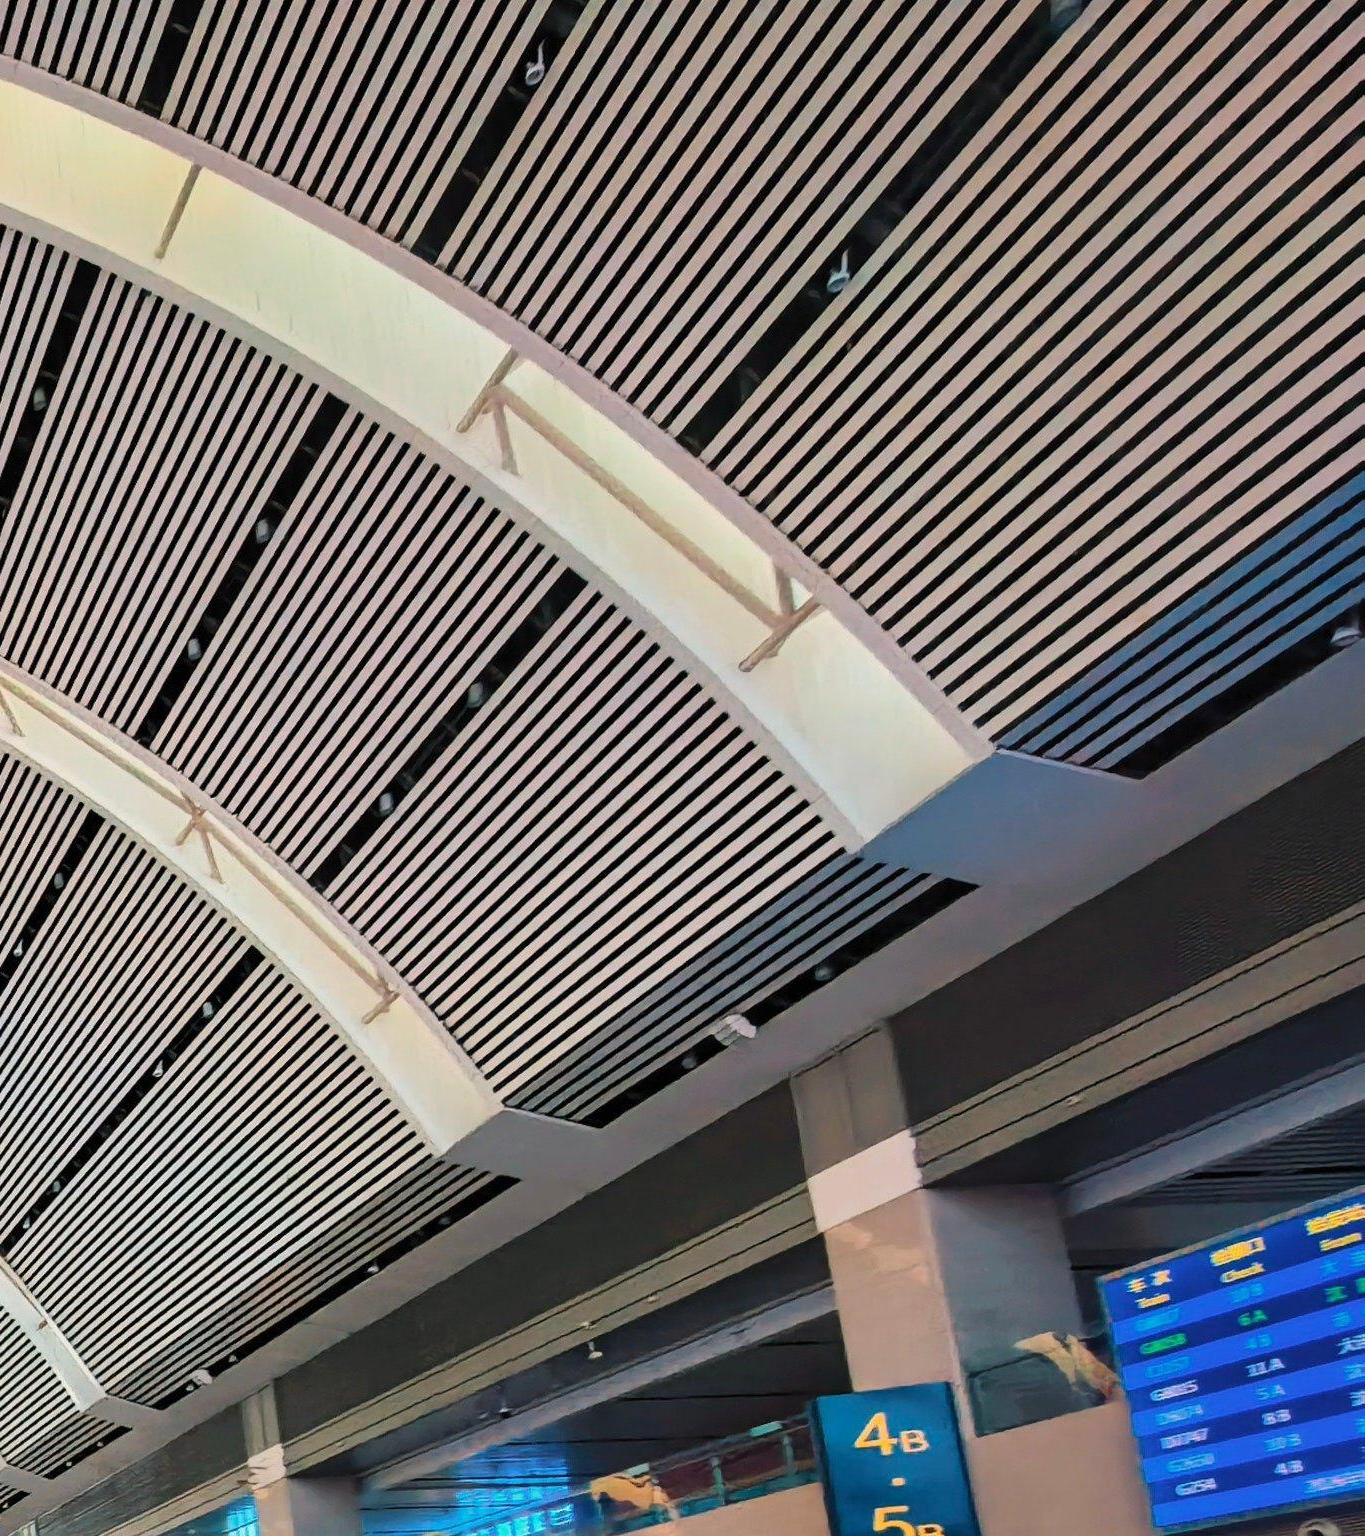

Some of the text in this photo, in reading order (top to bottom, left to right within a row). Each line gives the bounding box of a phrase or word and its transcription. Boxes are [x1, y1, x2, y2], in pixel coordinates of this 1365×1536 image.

[1245, 1358, 1286, 1377] 11A
[1256, 1384, 1286, 1400] 5A
[854, 1412, 930, 1456] 4B
